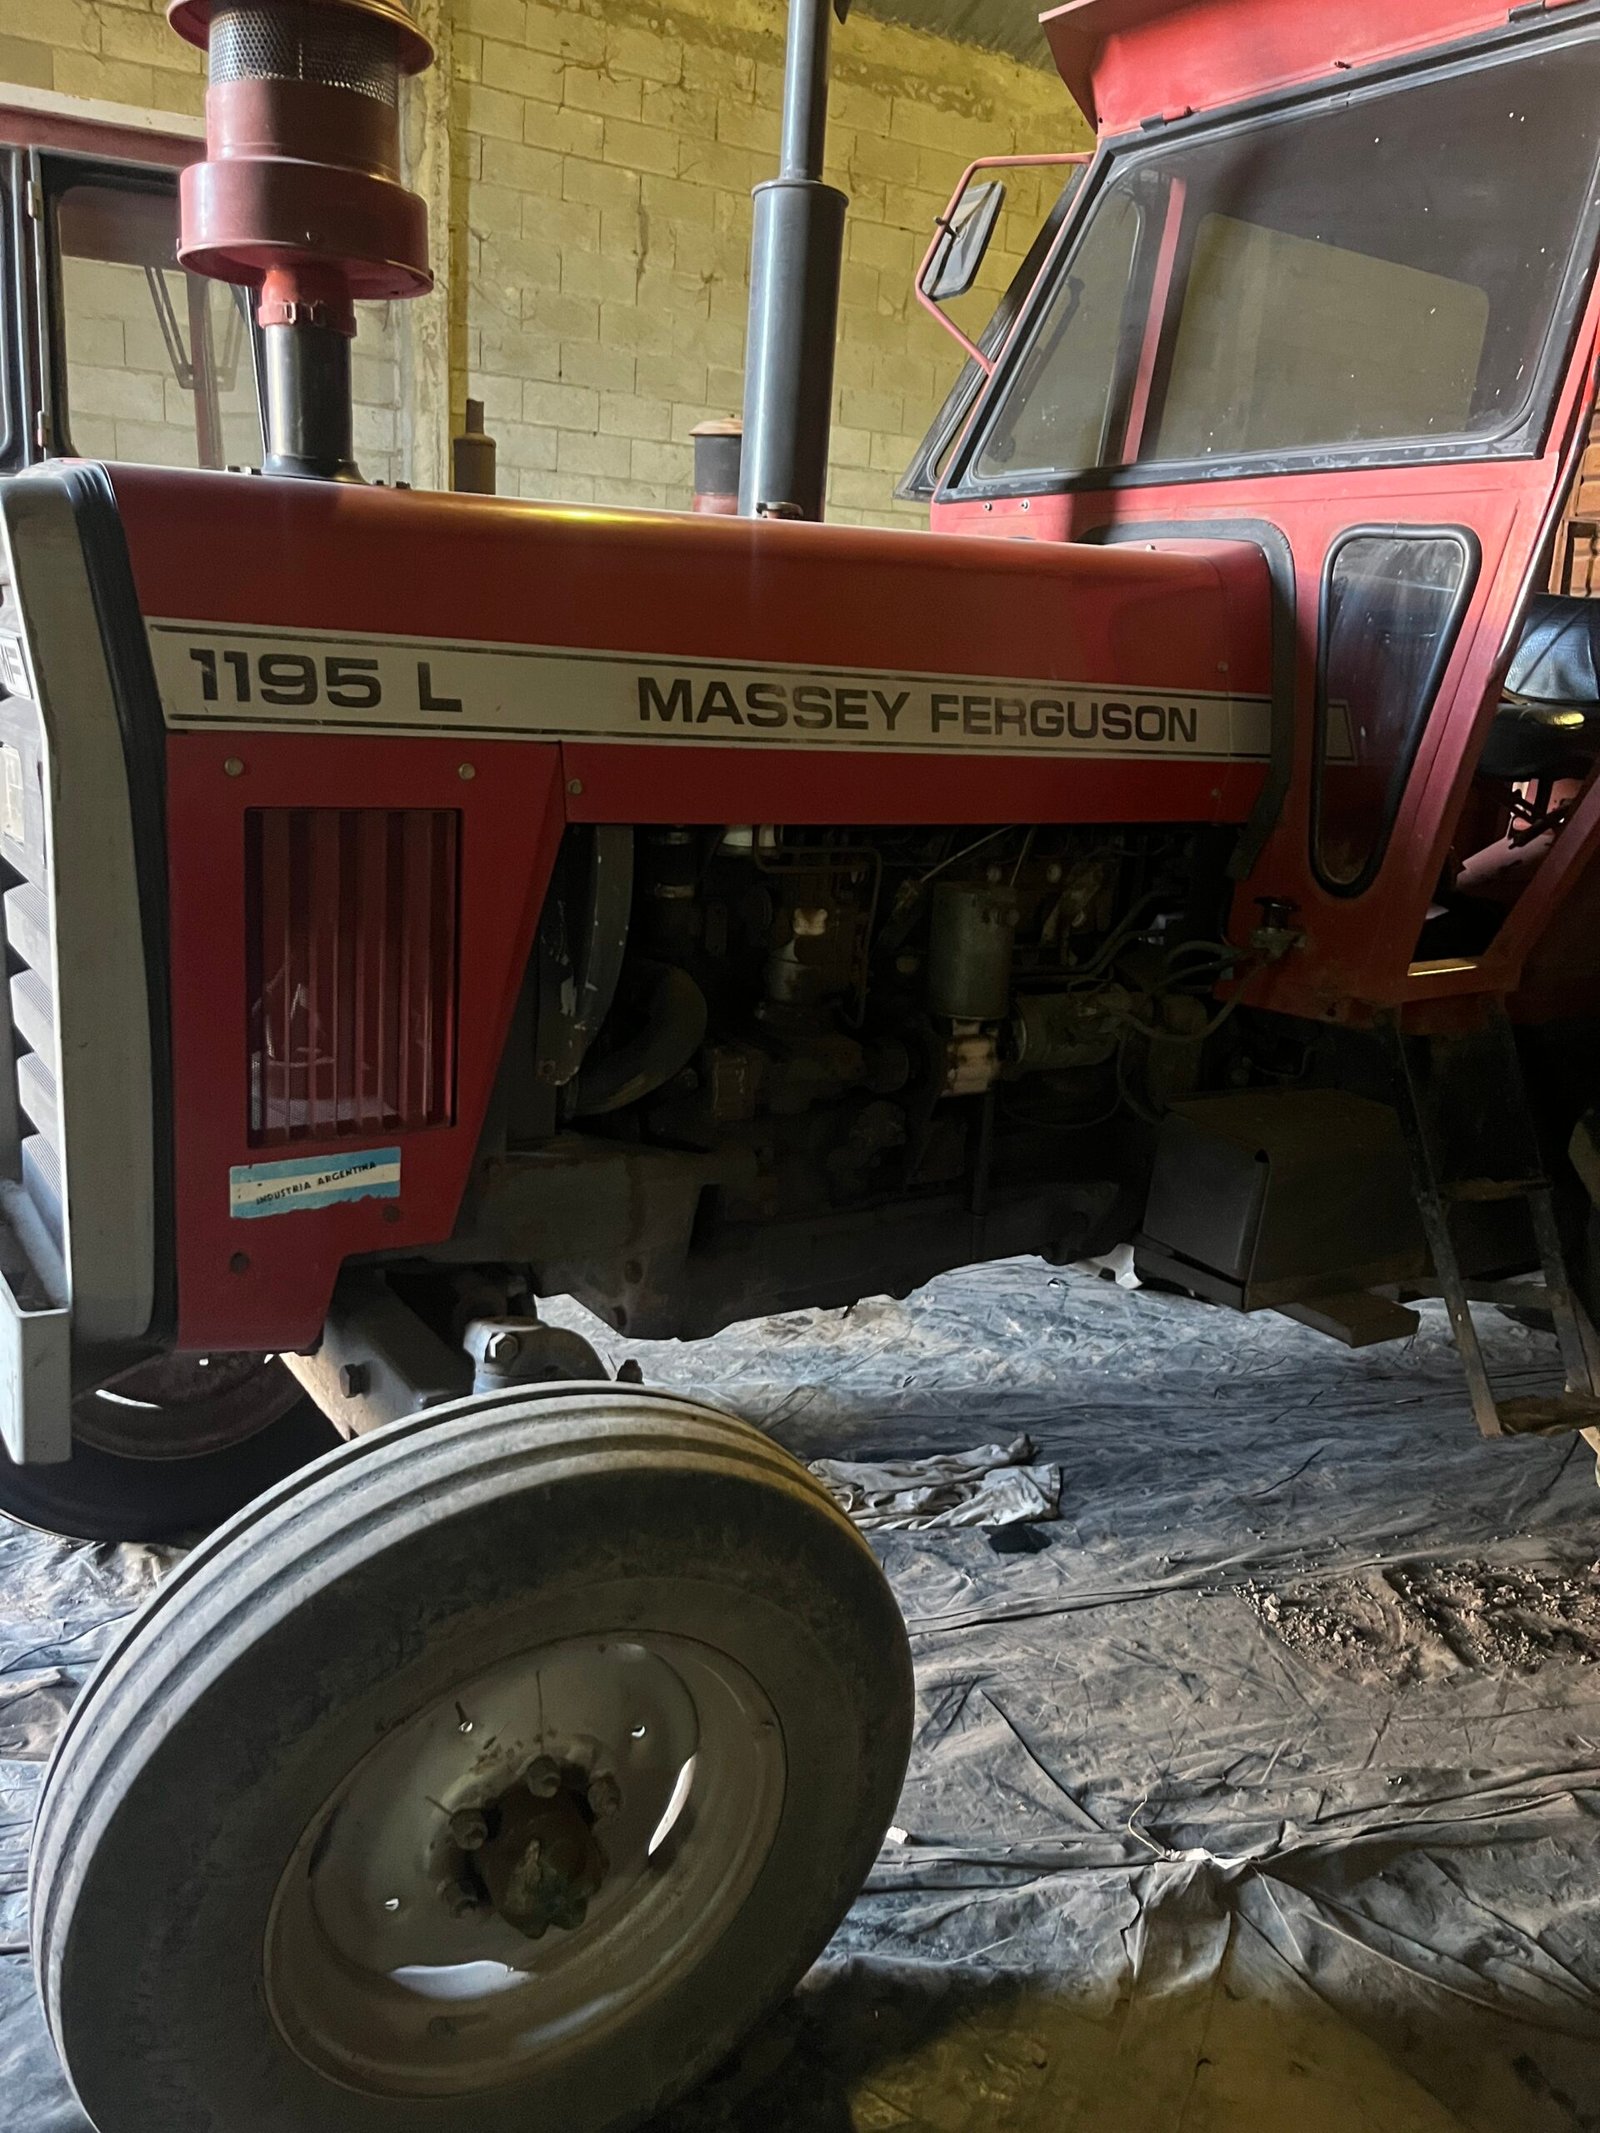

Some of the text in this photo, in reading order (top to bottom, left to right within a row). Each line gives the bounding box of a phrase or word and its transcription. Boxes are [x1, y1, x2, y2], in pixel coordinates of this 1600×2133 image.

[190, 648, 463, 712] 1195 L
[638, 677, 1197, 742] MASSEY FERGUSON
[256, 1161, 376, 1205] INDUSTRIA ARGENTINA
